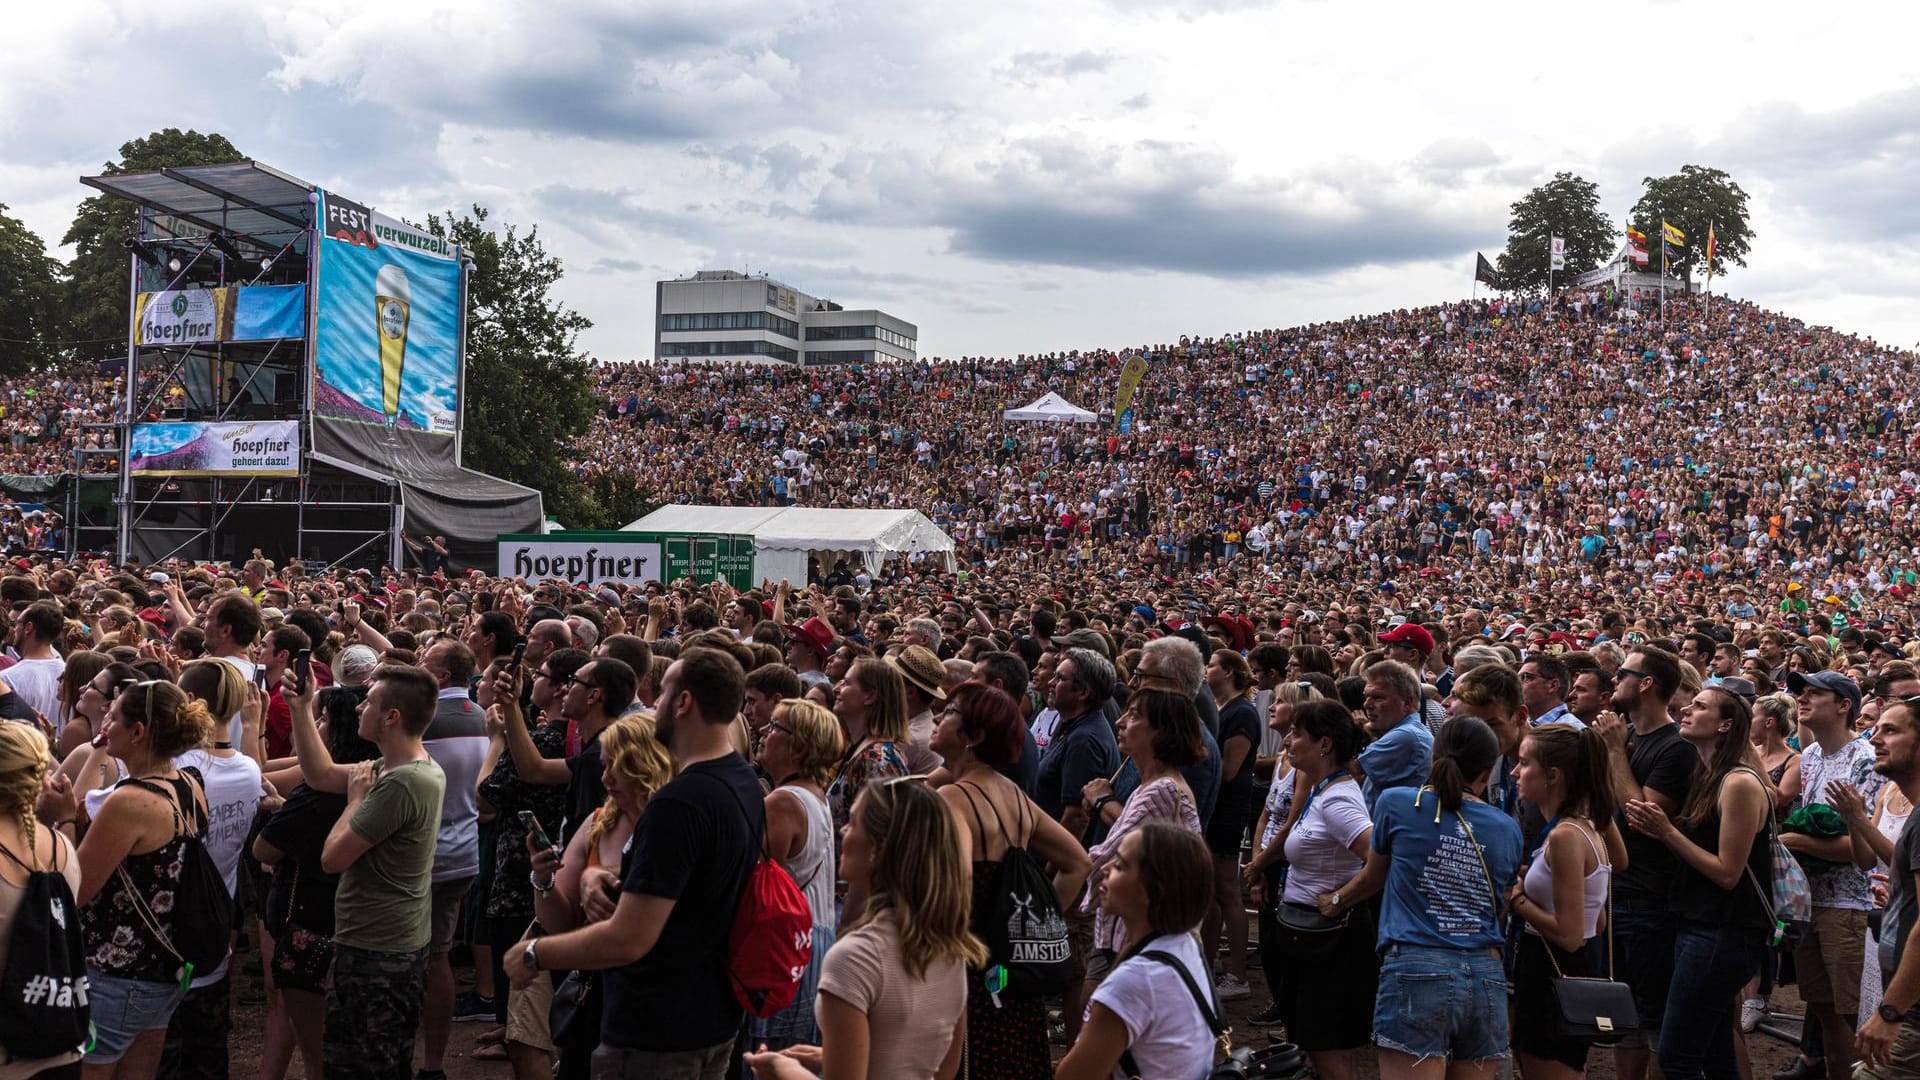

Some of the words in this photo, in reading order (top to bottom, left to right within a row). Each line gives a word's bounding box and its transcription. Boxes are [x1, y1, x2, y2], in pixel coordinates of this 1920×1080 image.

[329, 203, 368, 232] FEST
[375, 224, 450, 257] verwurzelt.
[223, 423, 256, 441] unser
[232, 456, 263, 468] gehoert
[265, 456, 290, 466] dazu!
[701, 568, 713, 576] BURG
[1440, 834, 1466, 847] FETTES
